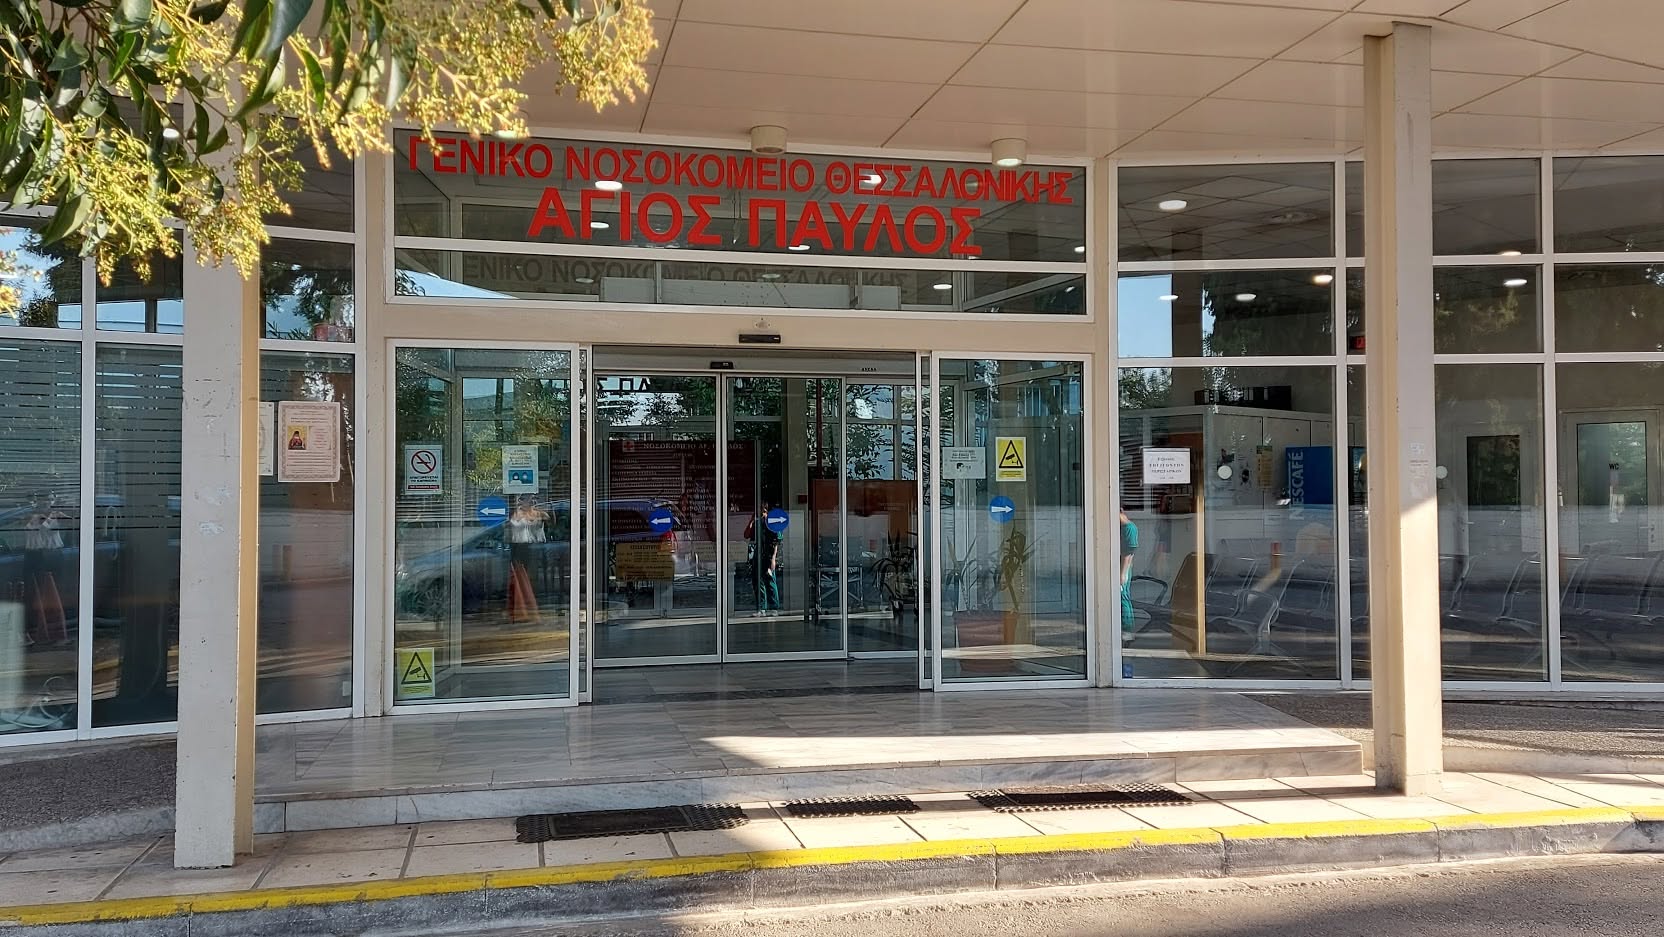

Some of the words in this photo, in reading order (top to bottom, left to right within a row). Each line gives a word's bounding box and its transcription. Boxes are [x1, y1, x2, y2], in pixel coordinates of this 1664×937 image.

[409, 136, 553, 180] ΓΕΝΙΚΟ
[566, 147, 815, 193] ΝΟΣΟΚΟΜΕΙΟ
[826, 161, 1073, 204] ΘΕΣΣΑΛΟΝΙΚΗΣ
[527, 187, 723, 245] ΑΓΙΟΣ
[748, 198, 982, 256] ΠΑΥΛΟΣ
[1289, 450, 1305, 521] NESCAFÉ
